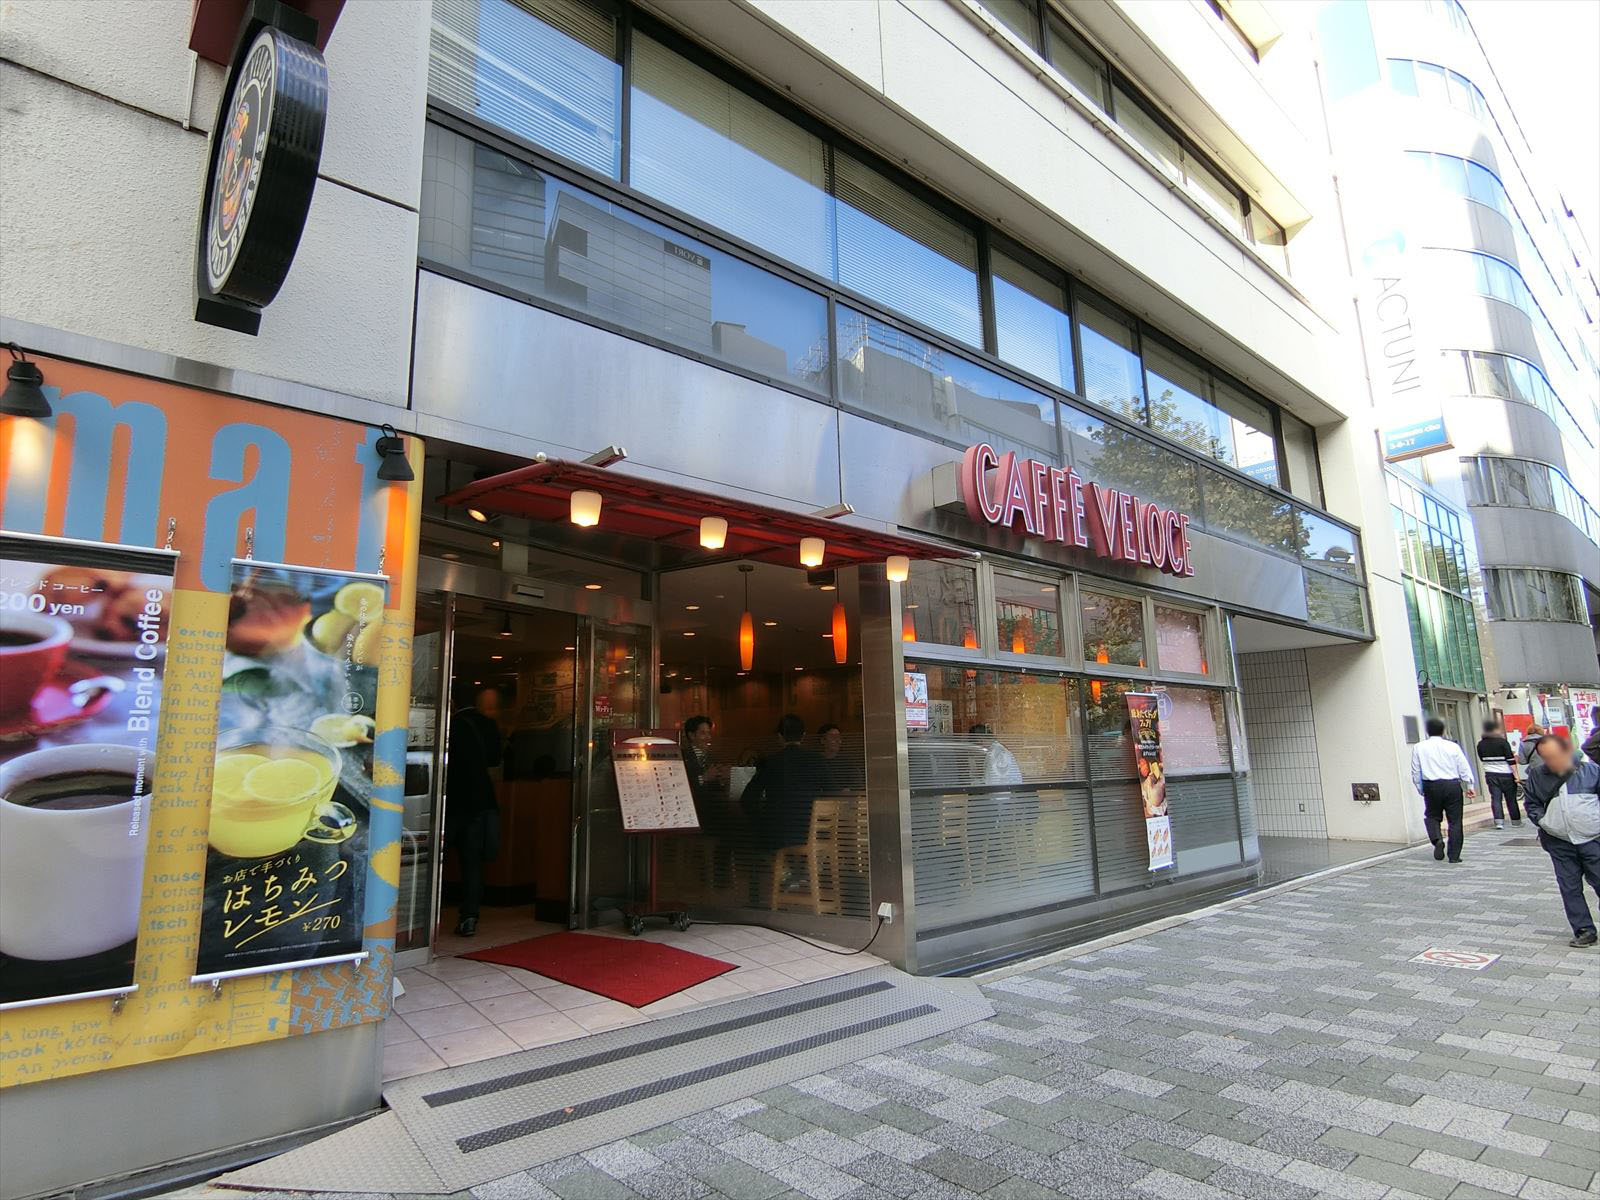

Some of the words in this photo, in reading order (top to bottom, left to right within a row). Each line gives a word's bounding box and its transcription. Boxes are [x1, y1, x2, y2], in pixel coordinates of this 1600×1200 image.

[1085, 481, 1195, 578] VELOCE
[53, 582, 104, 594] コーヒー
[49, 602, 85, 616] yen
[135, 588, 164, 660] Coffee
[127, 667, 156, 732] Blend
[139, 737, 149, 757] with
[135, 758, 147, 794] moment
[128, 795, 142, 836] Released
[223, 853, 301, 884] お店で手づくり
[223, 860, 348, 914] はちみつ
[223, 892, 319, 938] レモン
[303, 915, 341, 932] ¥270
